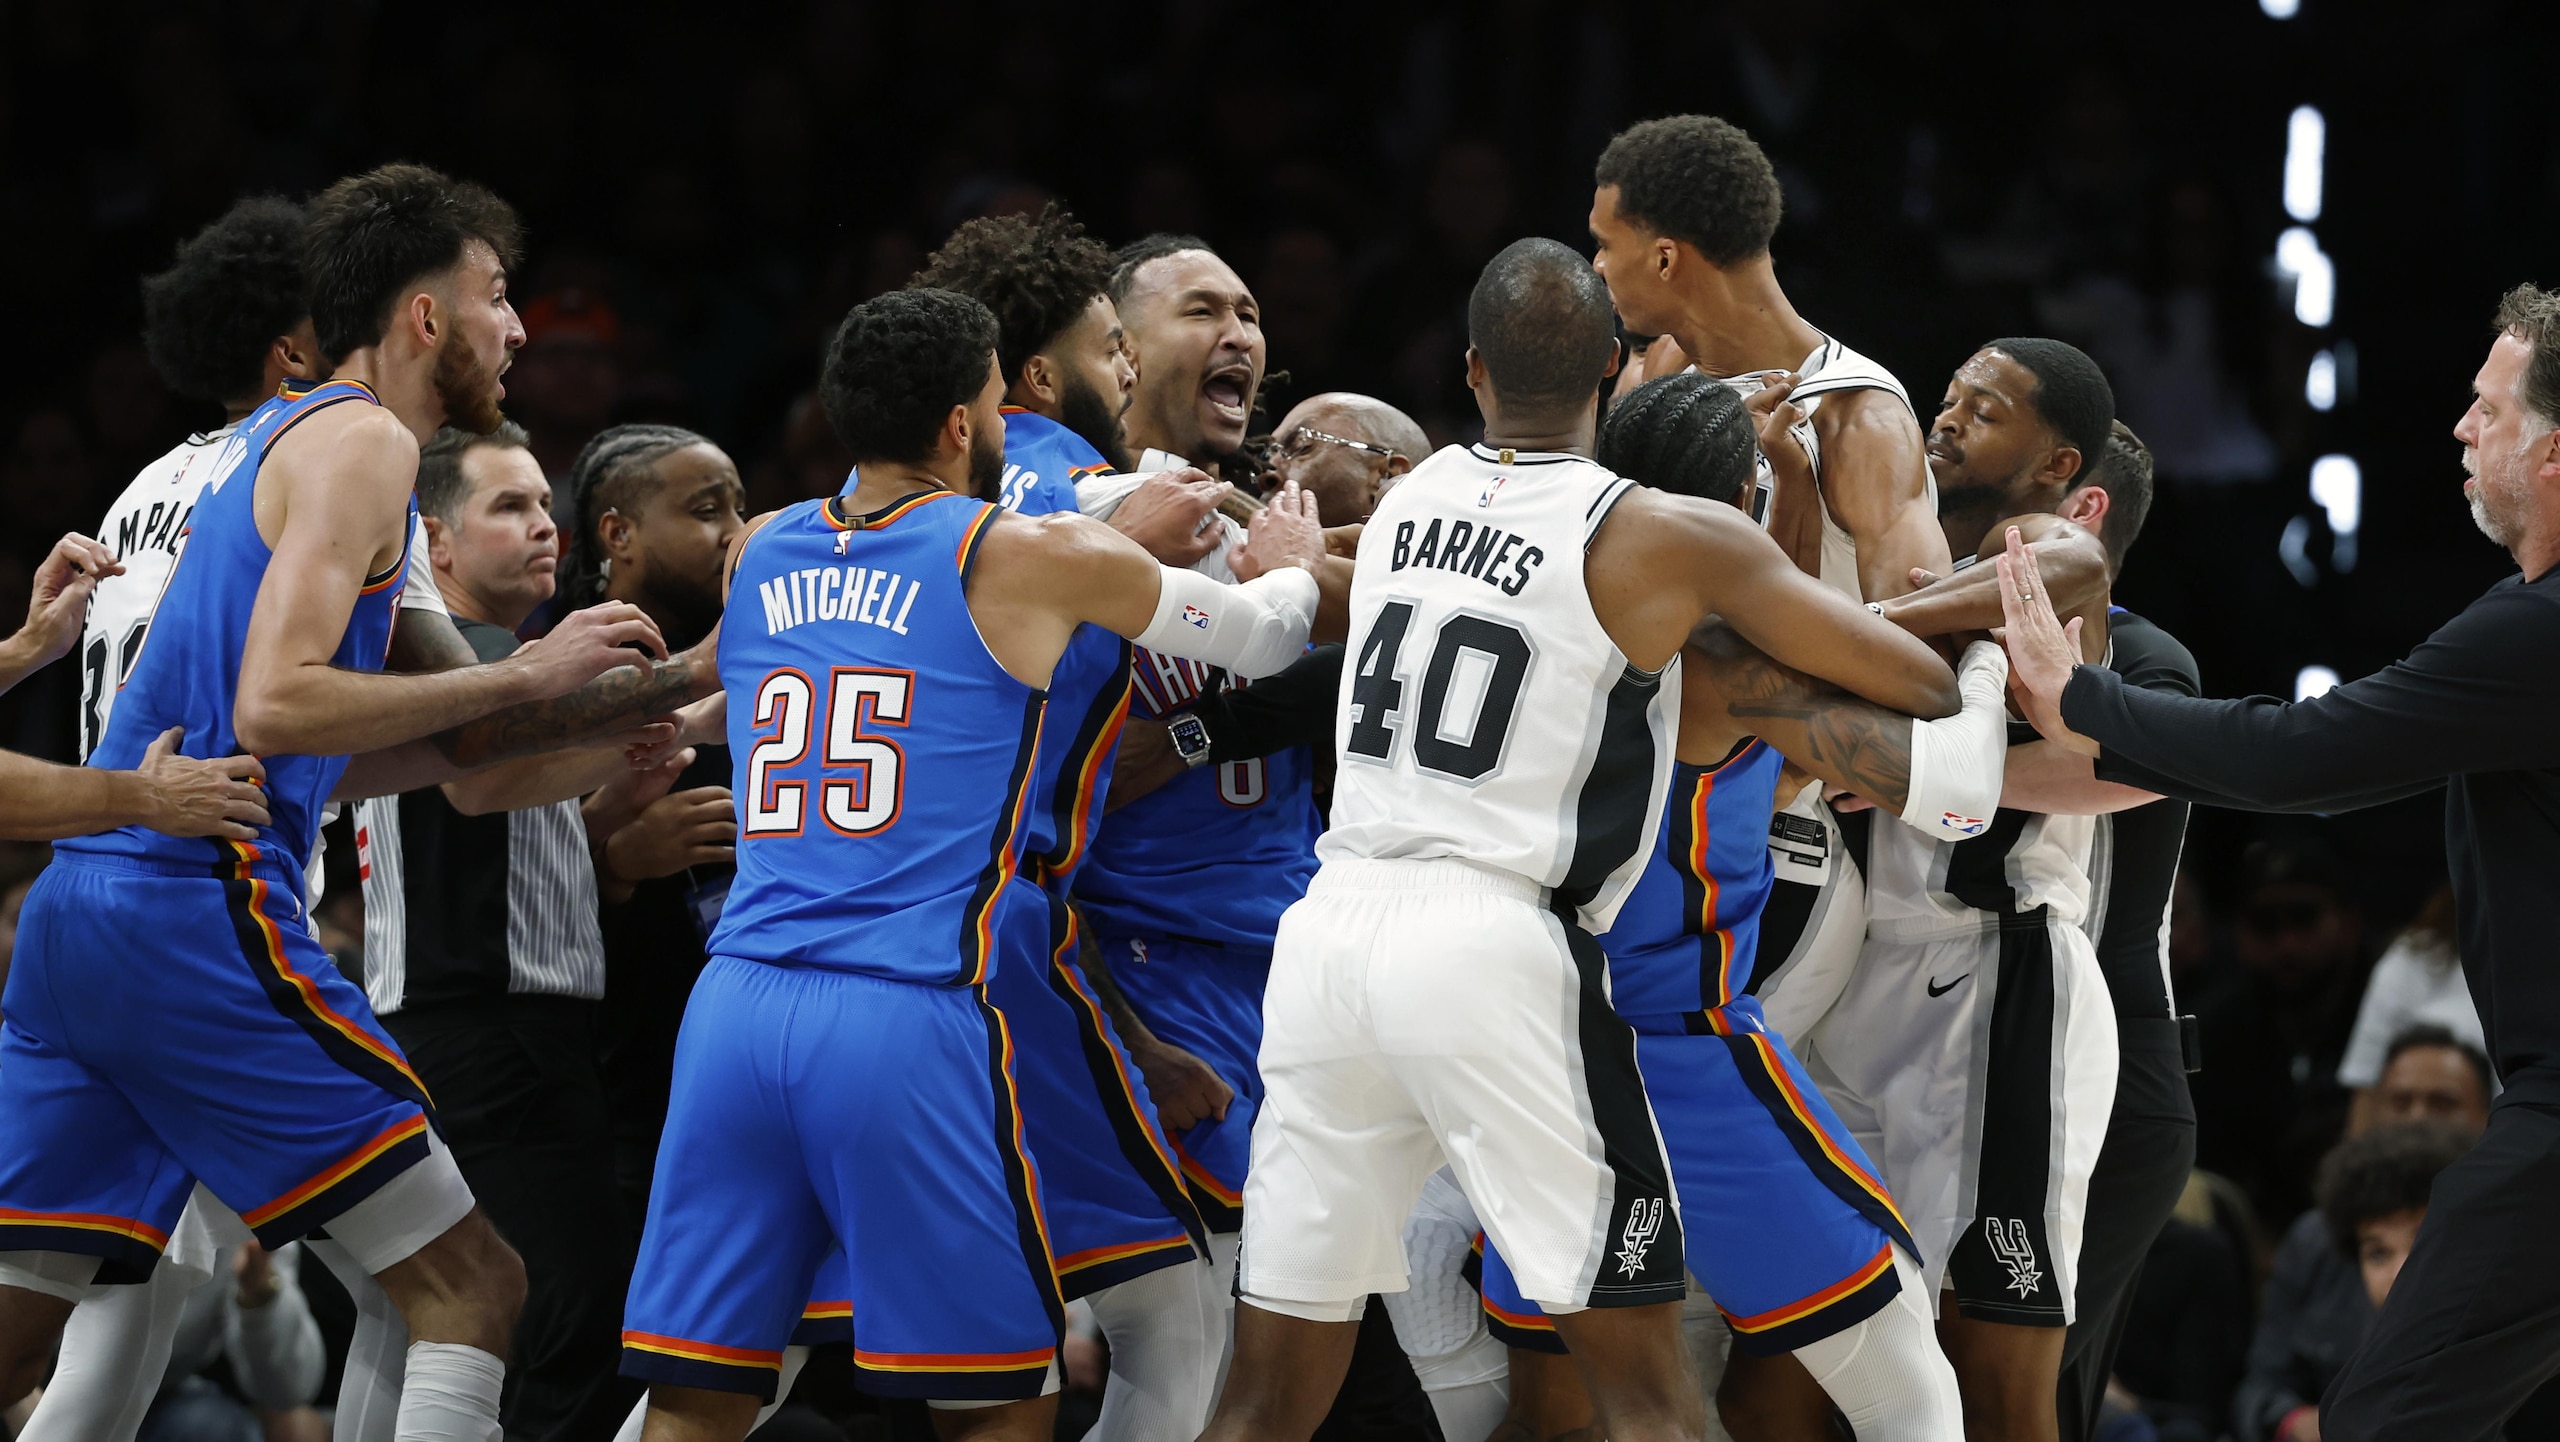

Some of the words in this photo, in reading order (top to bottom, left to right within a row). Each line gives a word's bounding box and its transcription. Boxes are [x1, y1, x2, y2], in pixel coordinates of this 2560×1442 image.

[759, 566, 921, 636] MITCHELL
[1391, 518, 1544, 597] BARNES
[743, 666, 916, 840] 25
[1344, 594, 1541, 789] 40
